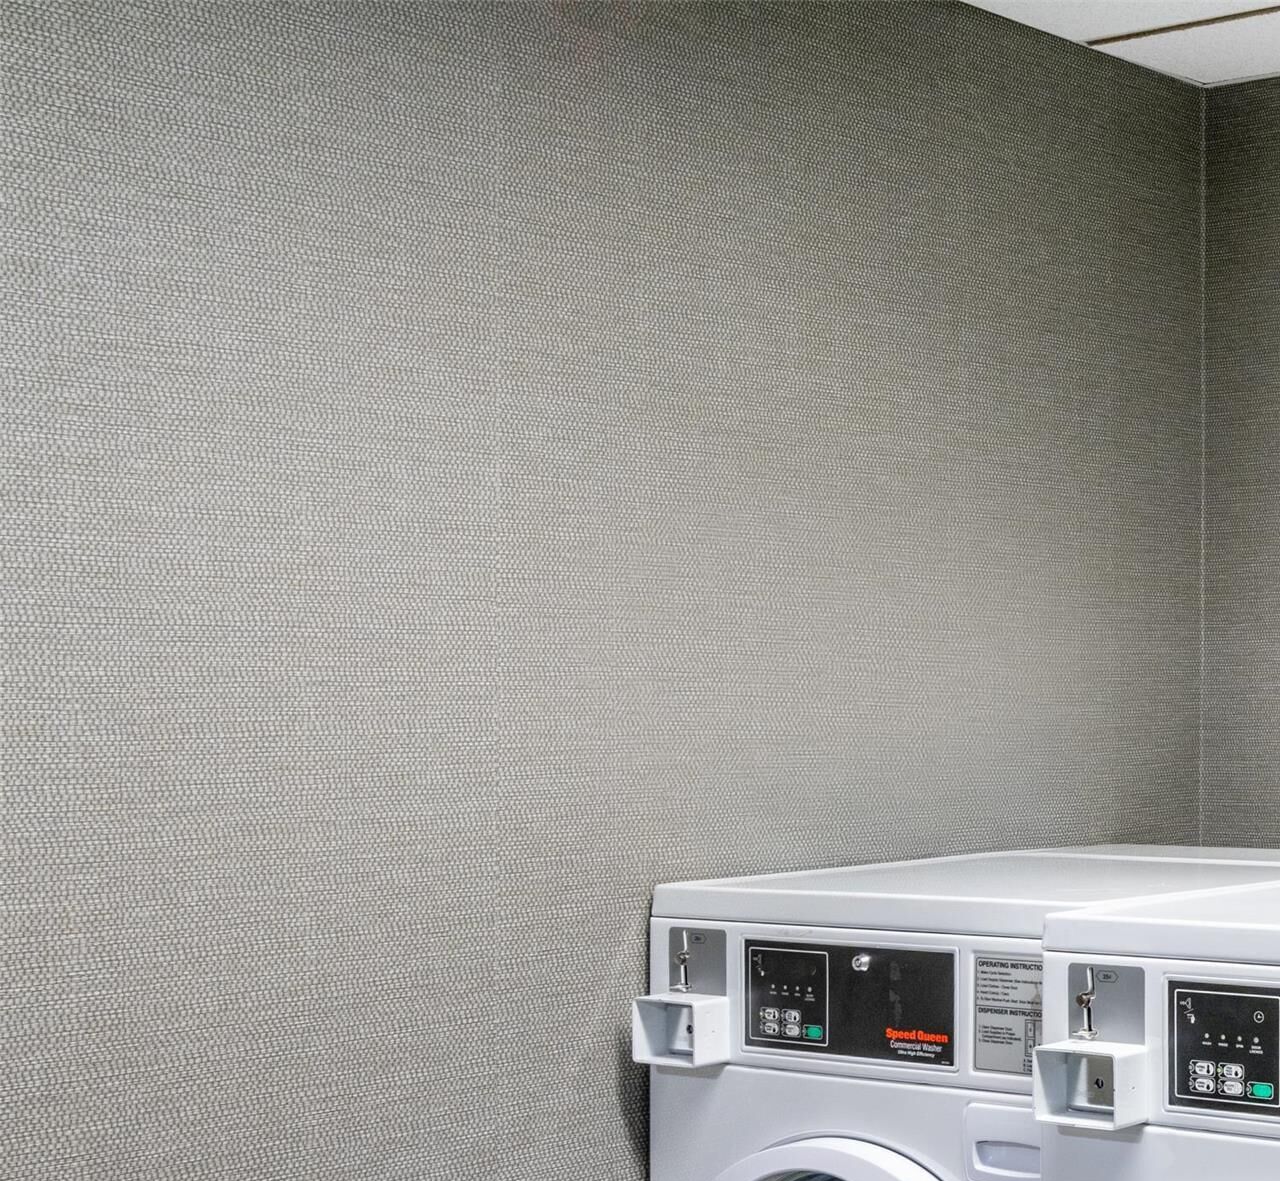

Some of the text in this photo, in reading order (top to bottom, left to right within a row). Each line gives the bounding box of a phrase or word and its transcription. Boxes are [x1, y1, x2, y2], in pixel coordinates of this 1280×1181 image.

[1010, 963, 1042, 971] INSTRUCTIO
[978, 1007, 1008, 1015] DISPENSER
[886, 1028, 948, 1042] Speed Queen
[890, 1040, 942, 1052] Commercial Washer
